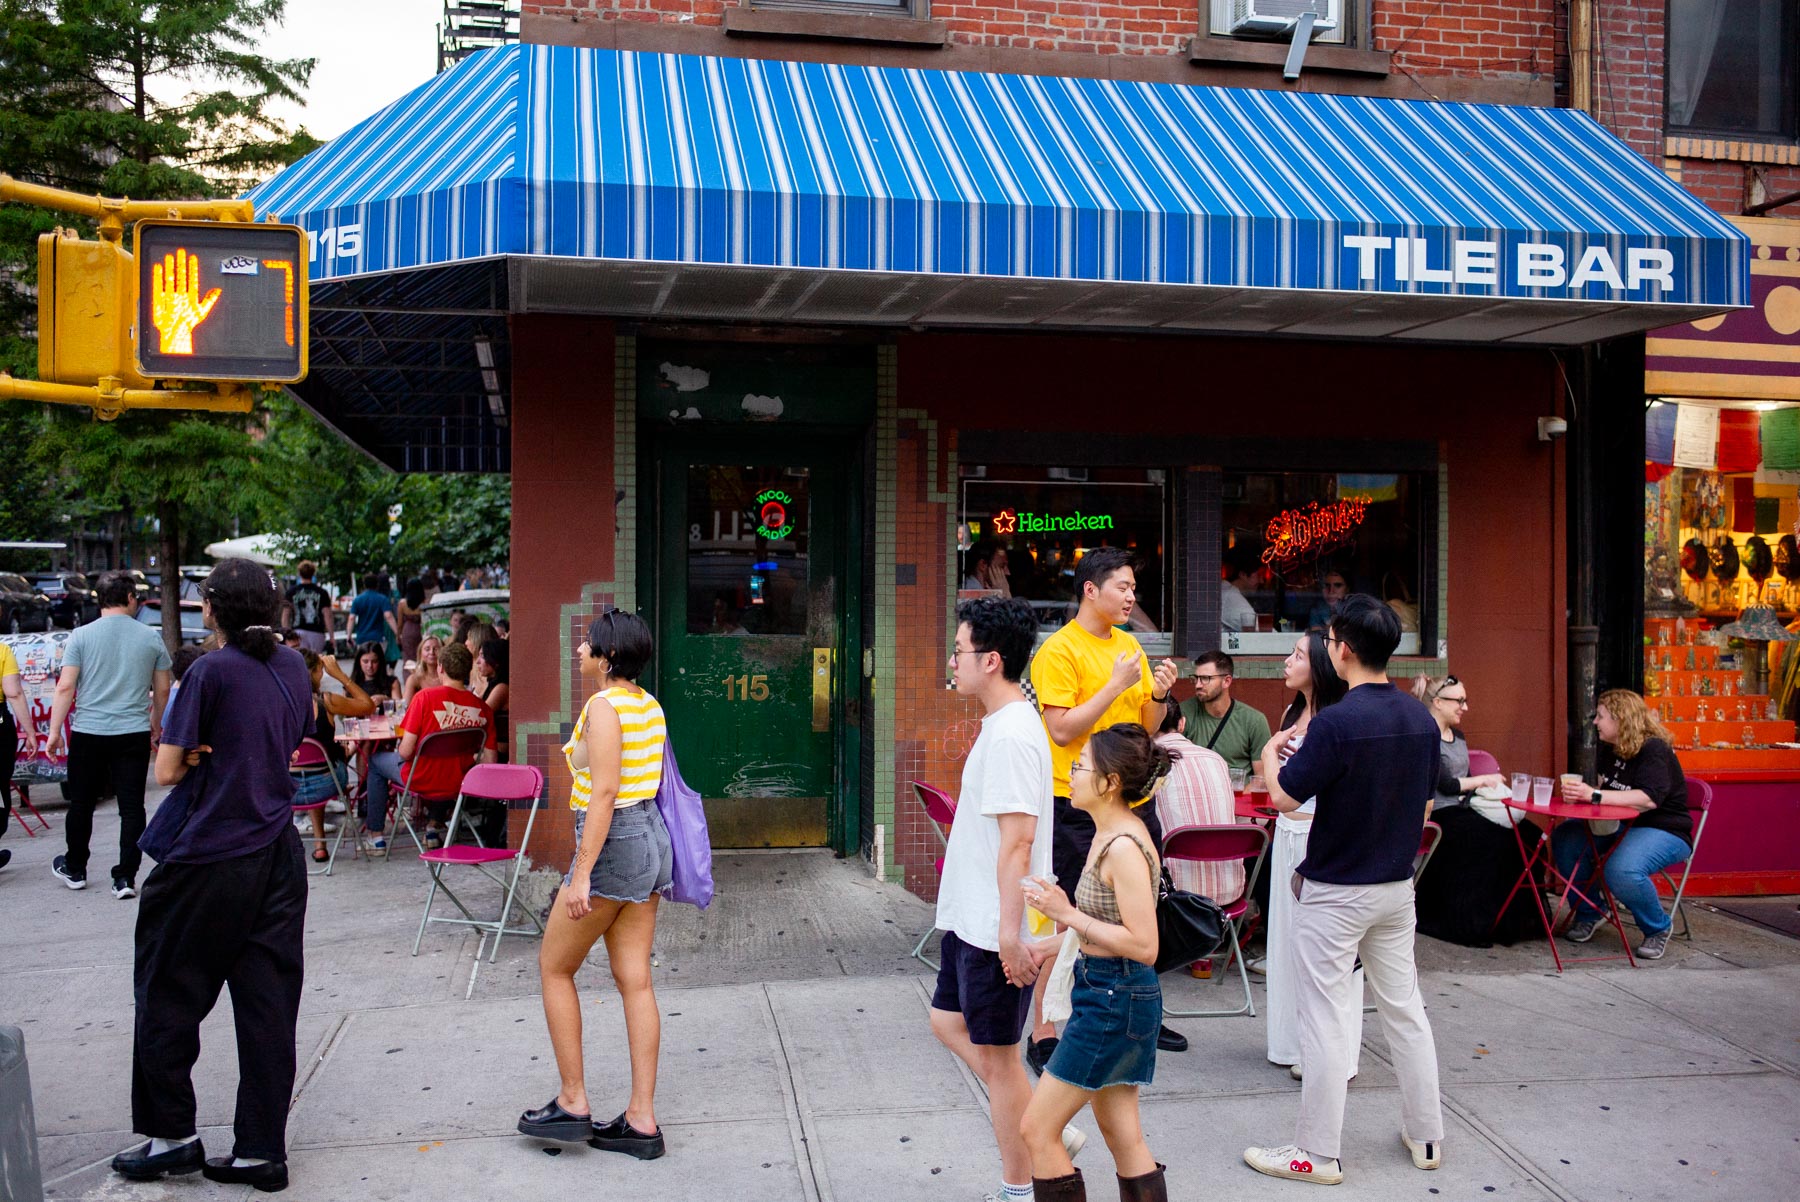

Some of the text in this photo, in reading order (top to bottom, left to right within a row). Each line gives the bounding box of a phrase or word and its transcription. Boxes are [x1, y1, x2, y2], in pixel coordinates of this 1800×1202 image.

[308, 223, 362, 263] 115
[1343, 235, 1675, 292] TILE BAR
[756, 489, 792, 505] WCOU
[1017, 511, 1114, 532] Heineken
[756, 524, 793, 541] RADIO
[722, 674, 770, 701] 115
[442, 714, 482, 727] FILSON
